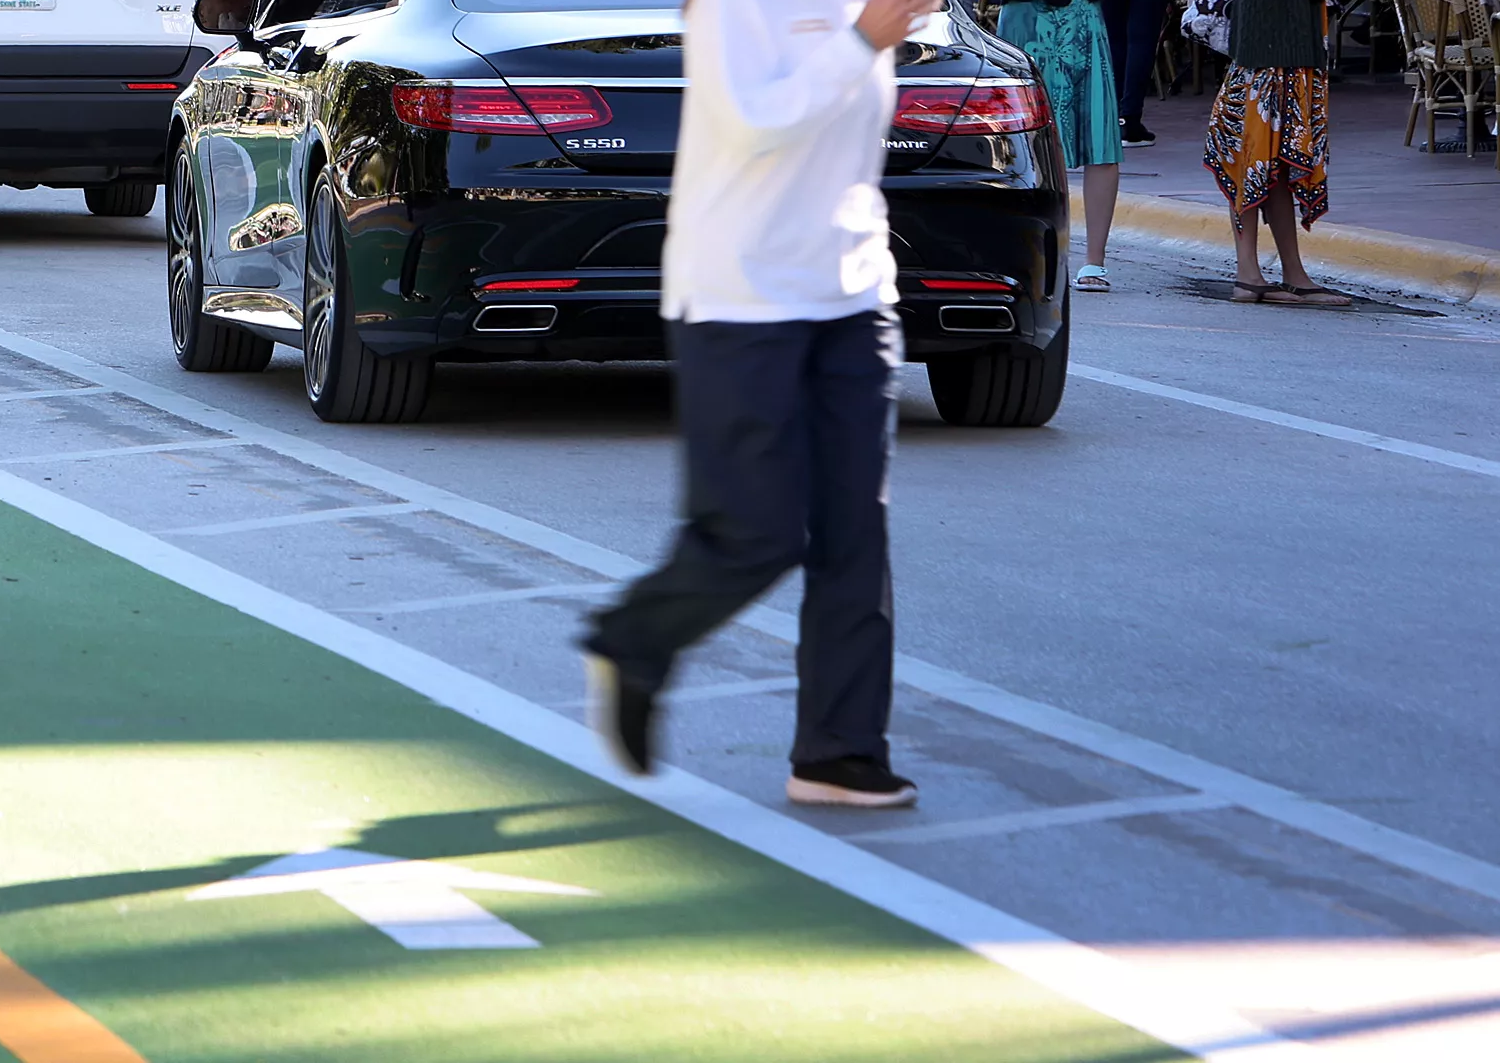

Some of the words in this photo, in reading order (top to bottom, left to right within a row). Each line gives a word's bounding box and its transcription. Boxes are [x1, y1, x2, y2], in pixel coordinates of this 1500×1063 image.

[156, 4, 182, 13] XLE
[566, 138, 580, 149] S
[583, 138, 626, 149] 550
